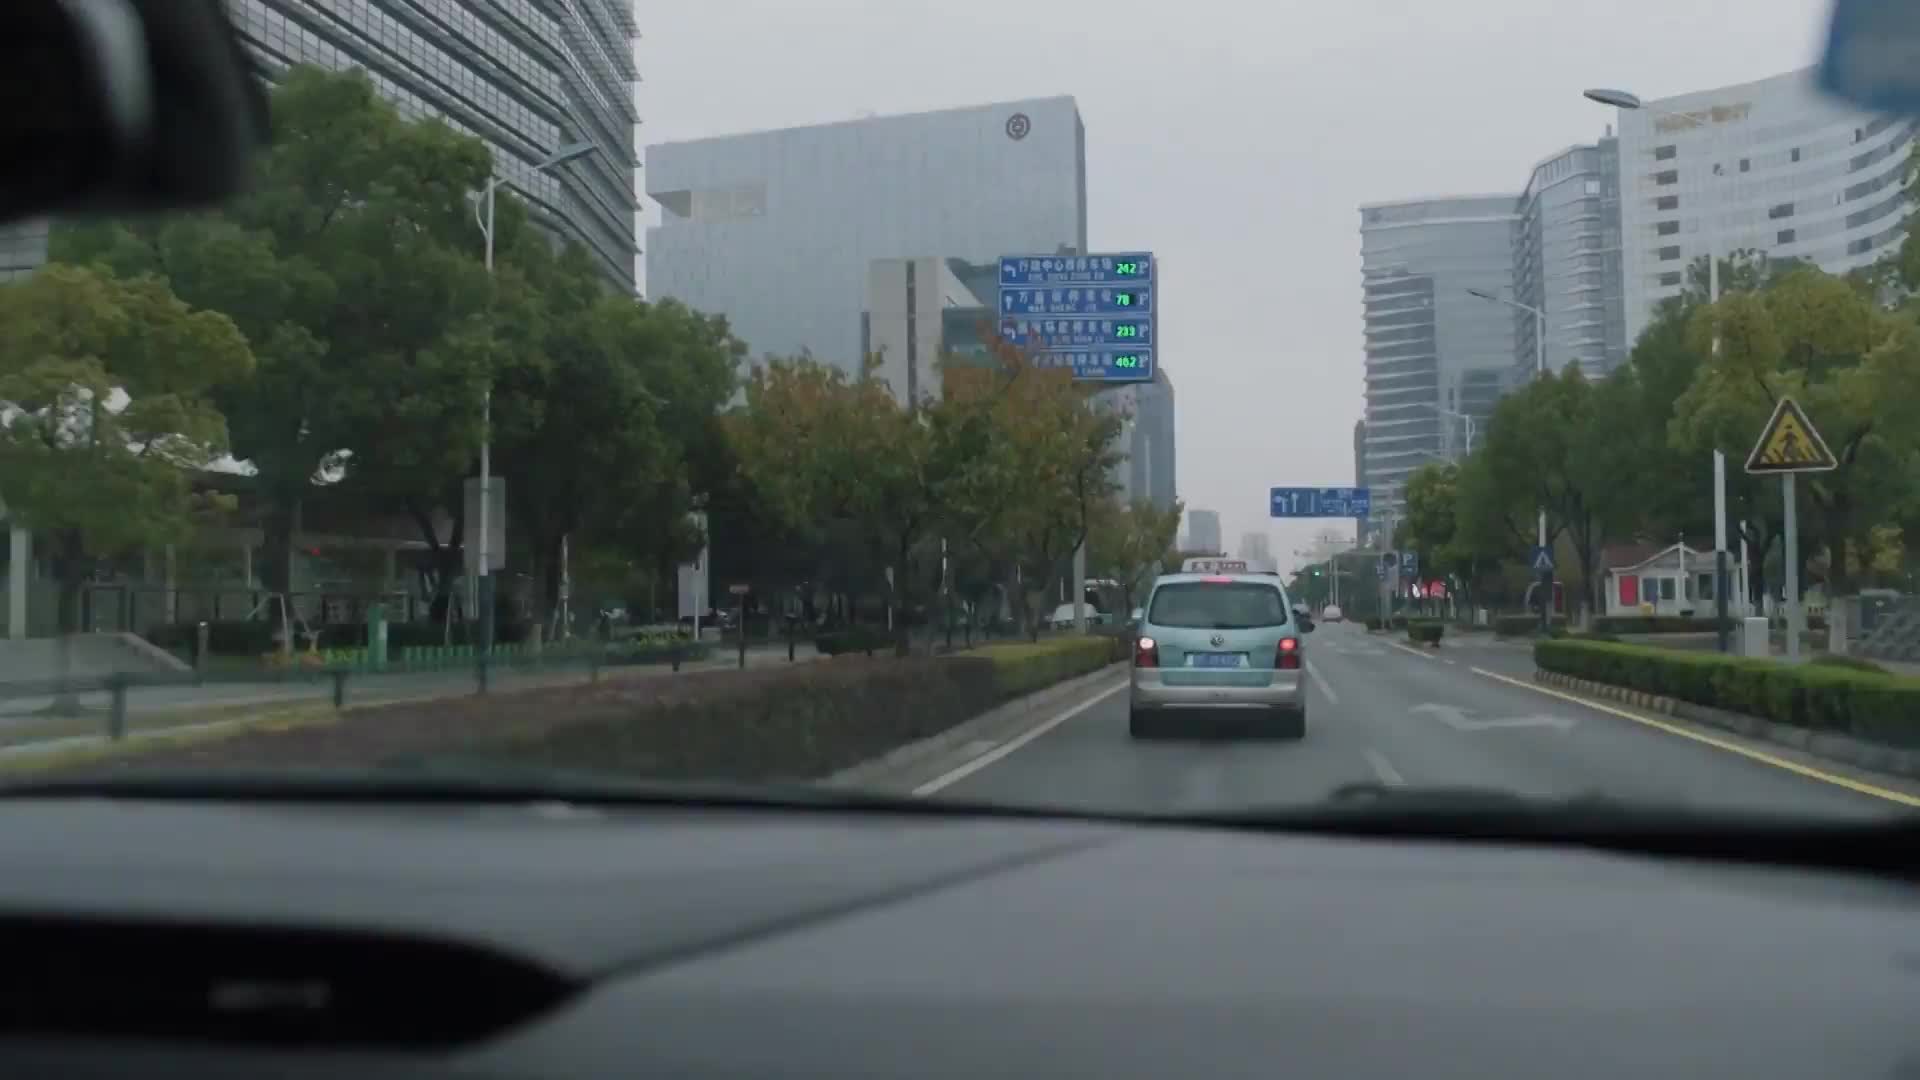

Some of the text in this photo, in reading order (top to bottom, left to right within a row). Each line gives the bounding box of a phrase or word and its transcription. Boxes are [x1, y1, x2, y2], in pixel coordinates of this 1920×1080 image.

[1116, 263, 1137, 275] 242
[1138, 261, 1149, 274] P
[1138, 293, 1149, 306] P
[1138, 323, 1149, 338] P
[1138, 353, 1149, 368] P
